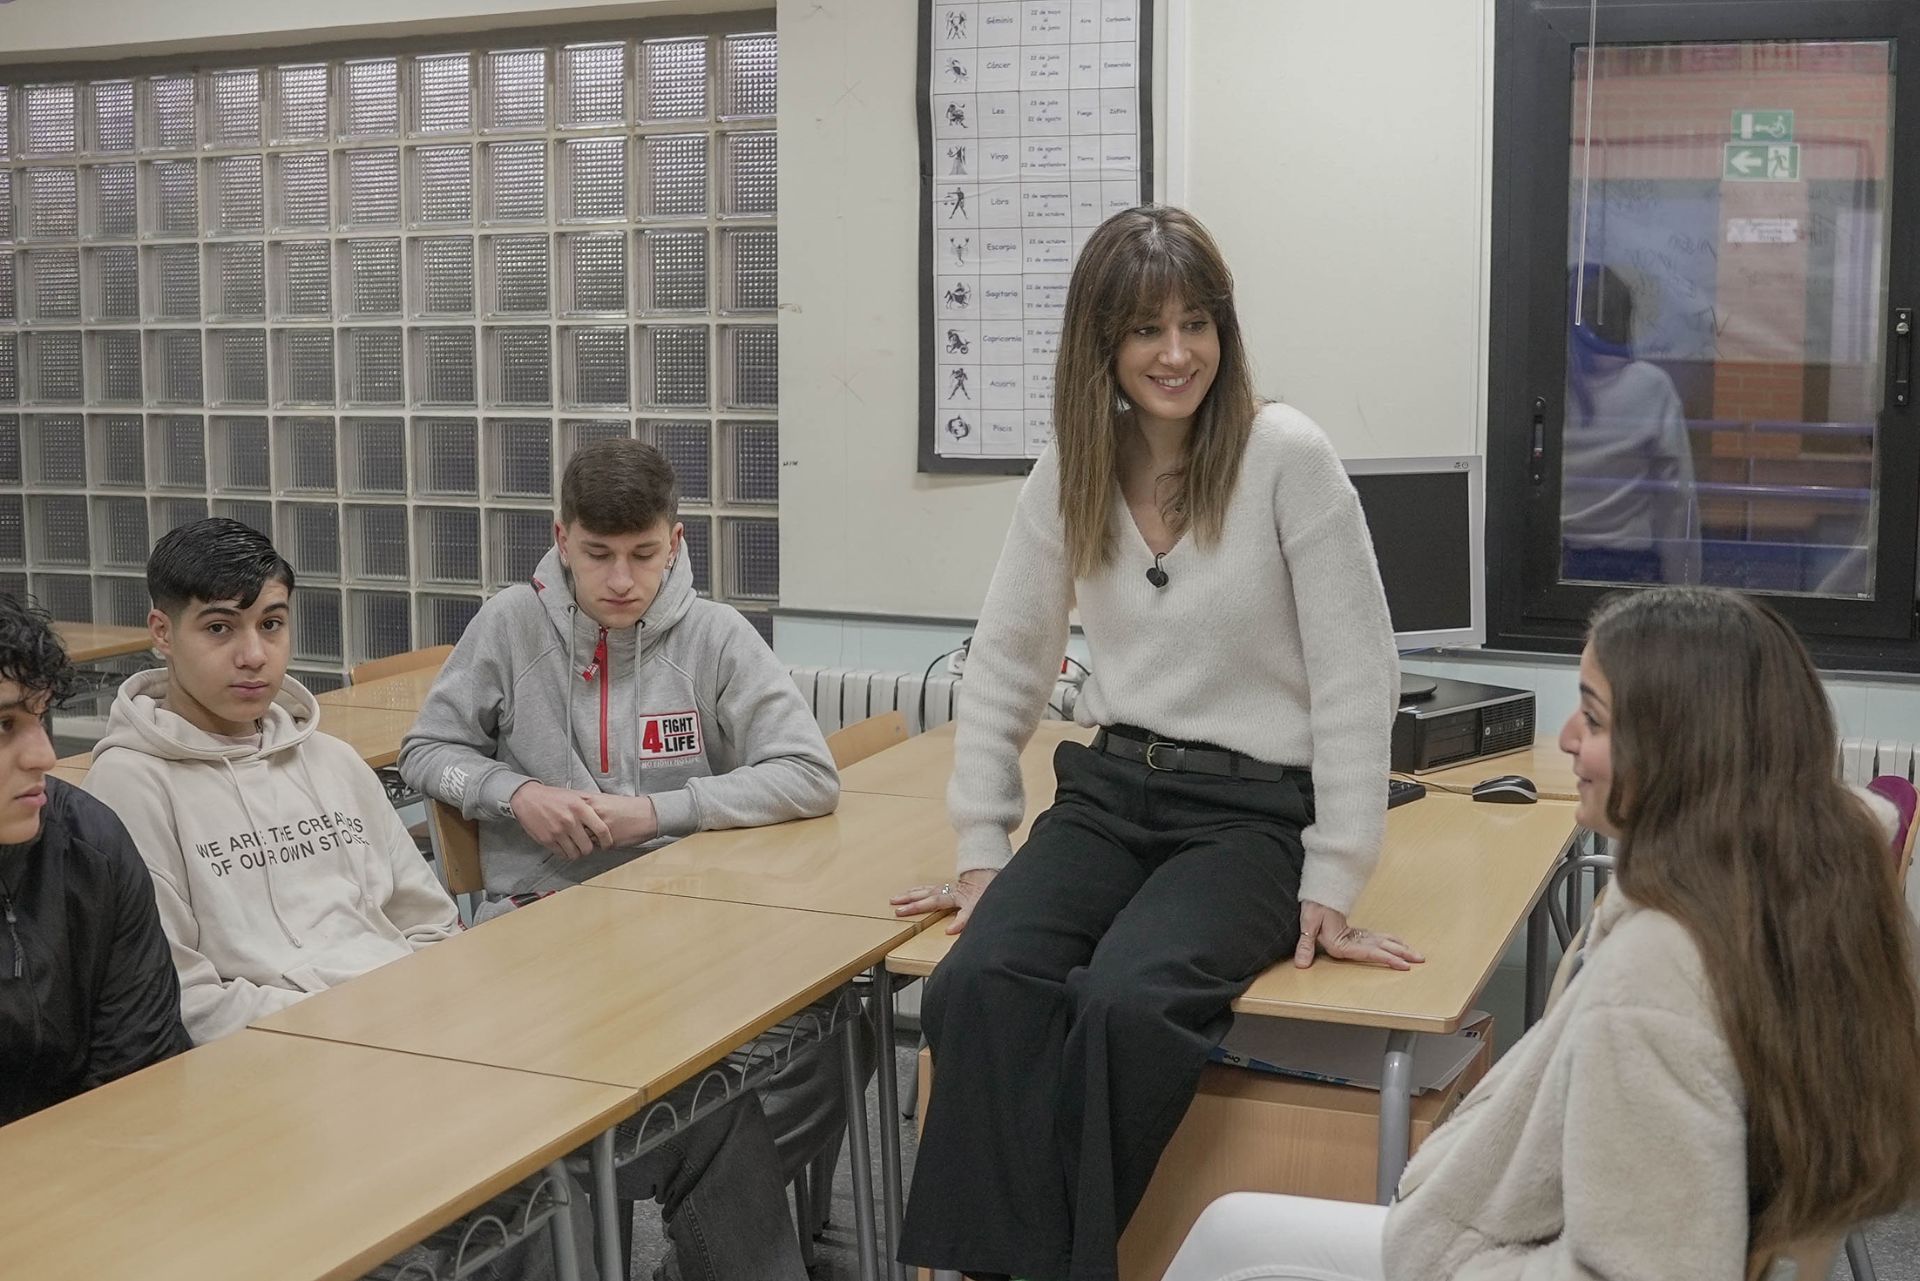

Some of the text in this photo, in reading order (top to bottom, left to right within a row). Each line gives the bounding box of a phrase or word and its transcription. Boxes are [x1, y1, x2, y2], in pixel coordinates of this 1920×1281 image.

[990, 153, 1008, 161] Virgo
[986, 243, 1016, 252] Escorpio
[985, 290, 1018, 299] Sagitario
[983, 335, 1022, 343] Capricornio
[993, 424, 1012, 432] Piscis
[662, 717, 693, 734] FIGHT
[642, 720, 663, 753] 4
[664, 735, 696, 752] LIFE
[195, 841, 223, 859] WE
[268, 825, 295, 844] THE
[211, 859, 233, 877] OF
[240, 850, 278, 871] OUR
[280, 840, 316, 864] OWN
